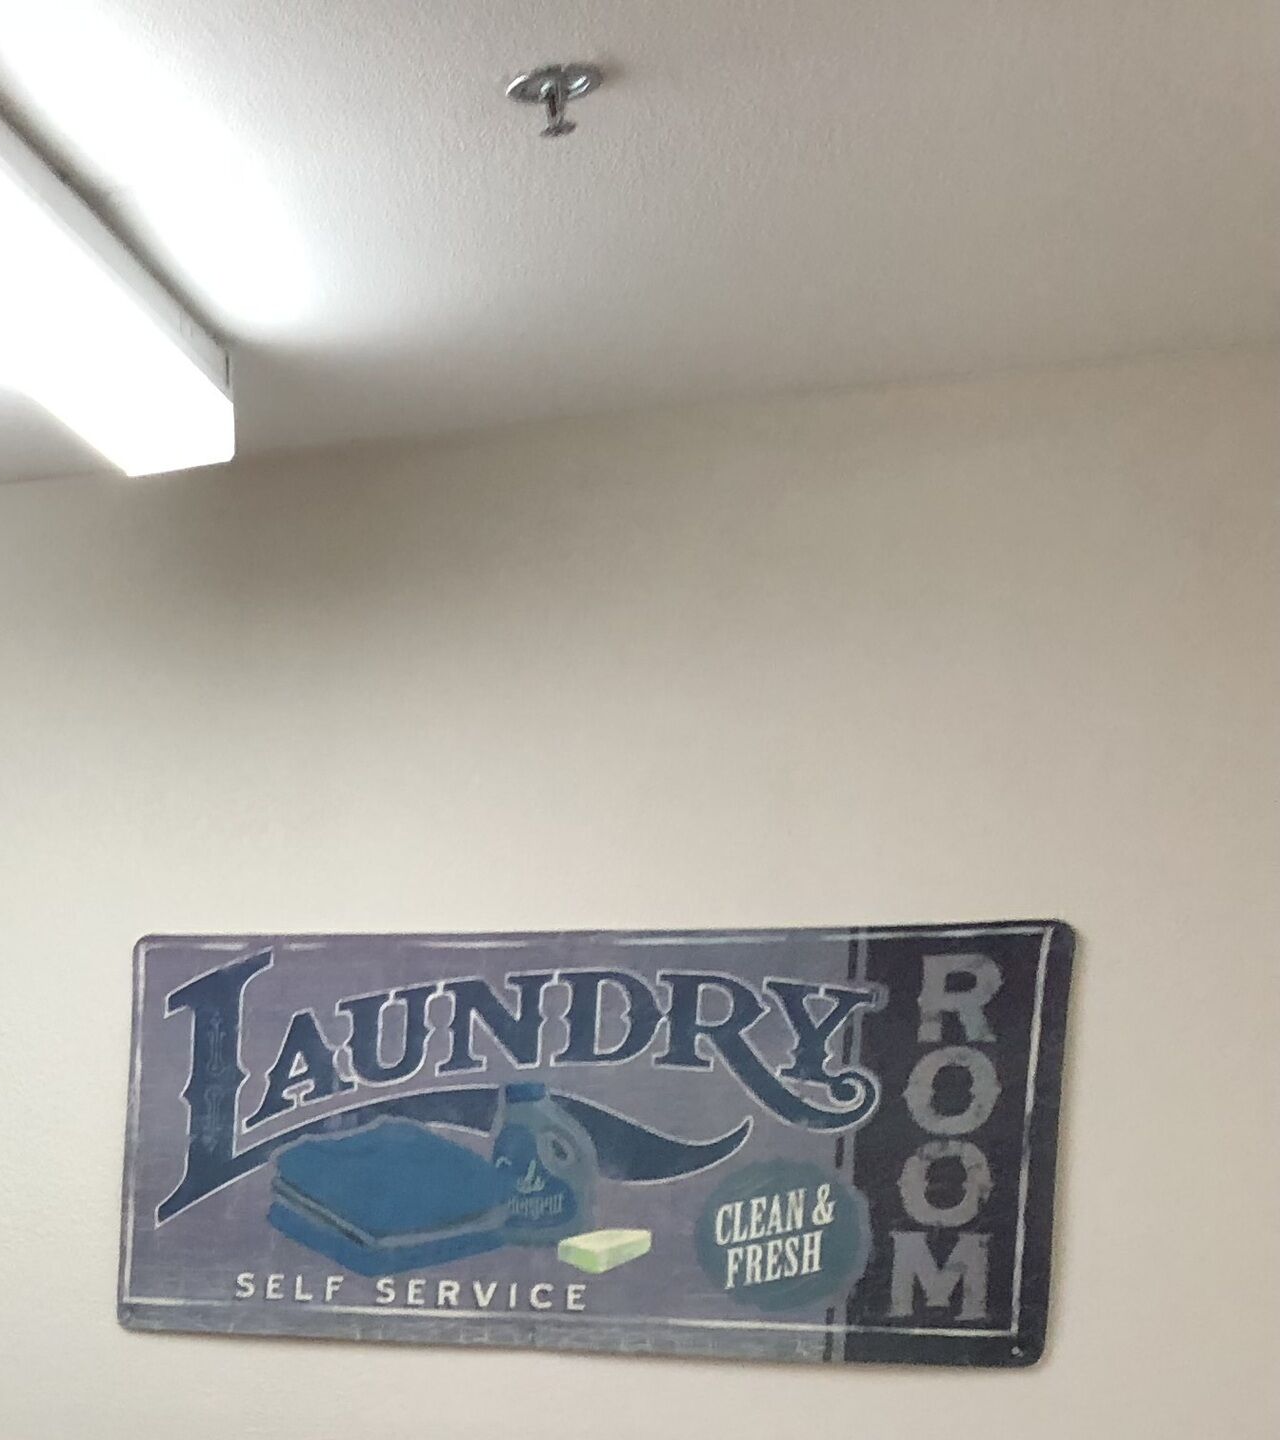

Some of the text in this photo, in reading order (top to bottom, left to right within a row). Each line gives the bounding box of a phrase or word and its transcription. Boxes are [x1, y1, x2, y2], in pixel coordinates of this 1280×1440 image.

[154, 946, 882, 1230] LAUNDRY
[888, 951, 1007, 1324] ROOM
[713, 1182, 837, 1248] CLEAN &
[234, 1271, 589, 1312] SELF SERVICE
[723, 1236, 824, 1291] FRESH
